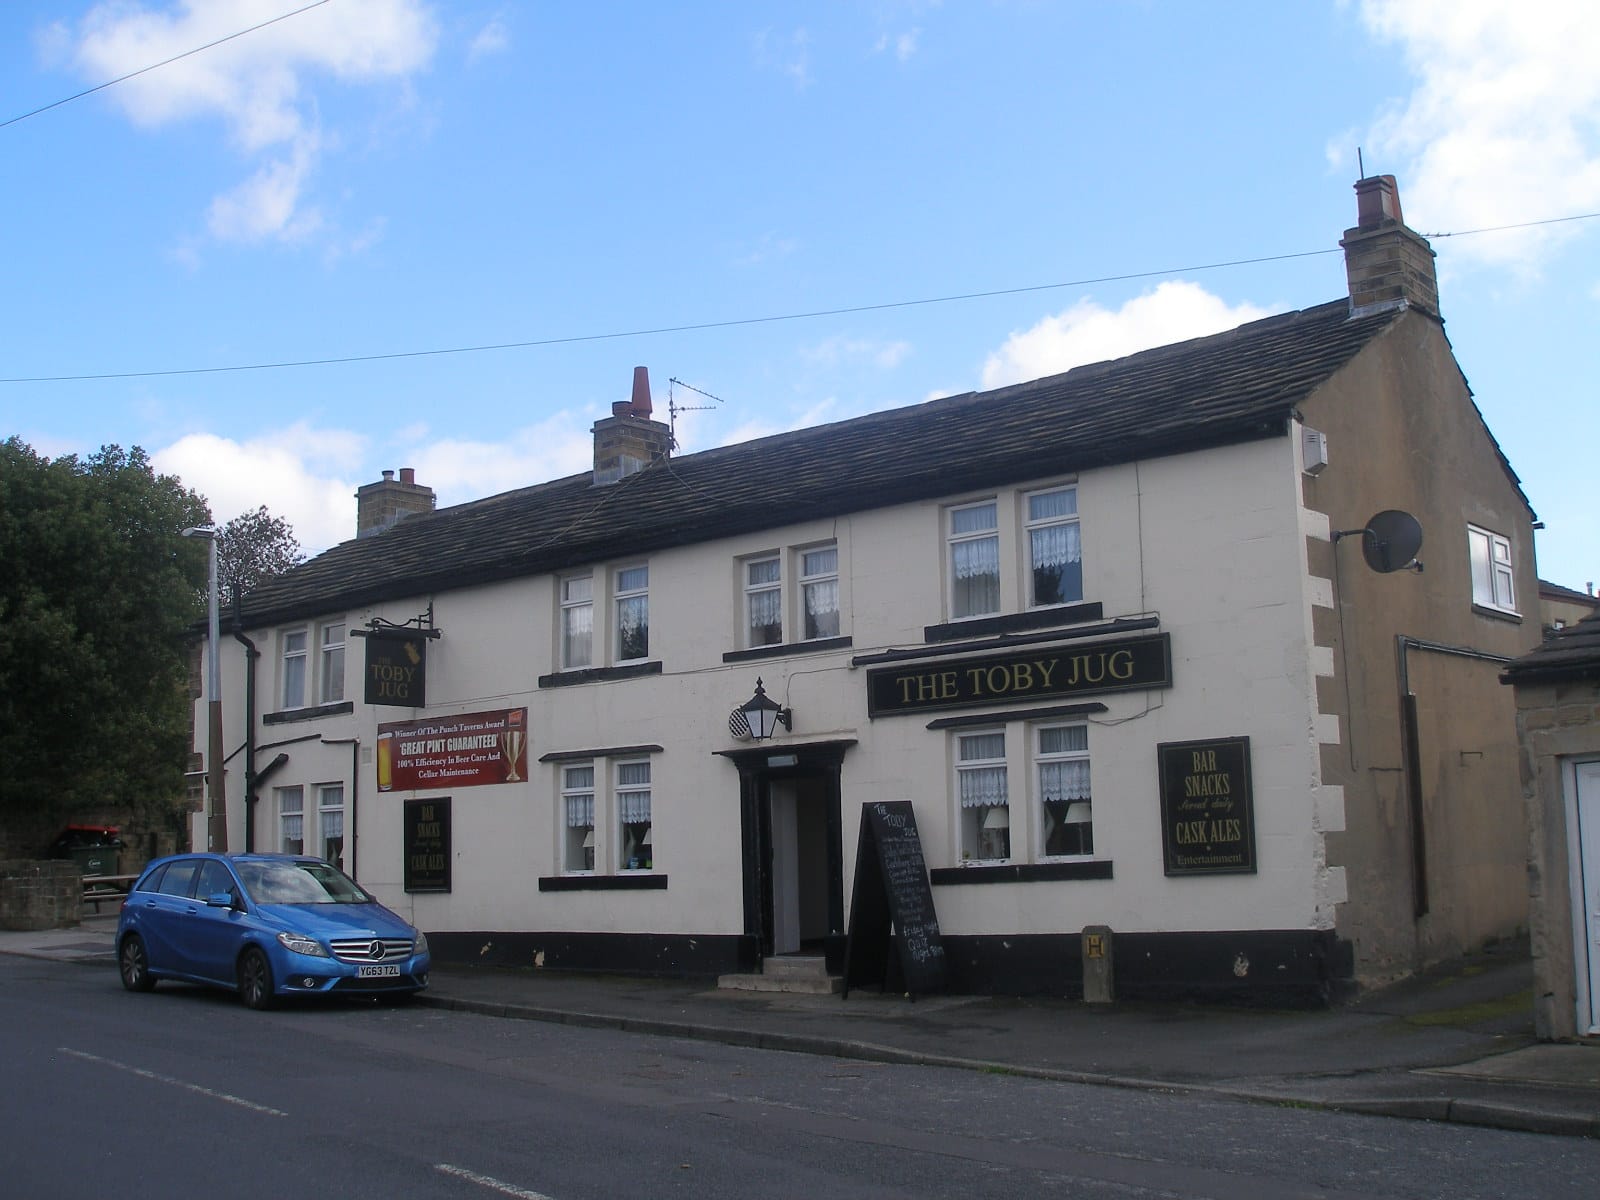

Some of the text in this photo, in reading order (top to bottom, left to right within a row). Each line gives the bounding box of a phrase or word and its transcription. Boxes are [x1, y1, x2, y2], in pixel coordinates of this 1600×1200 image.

[371, 664, 415, 682] TOBY
[896, 650, 1135, 702] THE TOBY JUG
[378, 682, 408, 698] JUG
[395, 719, 505, 738] Winner Of The Punch Taverns Award
[426, 739, 446, 753] PINT
[397, 751, 501, 768] 100% Efficiency In Beer Care And
[1193, 751, 1216, 773] BAR
[418, 767, 480, 778] Cellar Maintenance
[1185, 773, 1230, 797] SNACKS
[1176, 819, 1241, 844] CASK ALES
[1178, 854, 1242, 865] Entertainment
[1089, 936, 1102, 955] H
[361, 965, 399, 976] YG63 TZL
